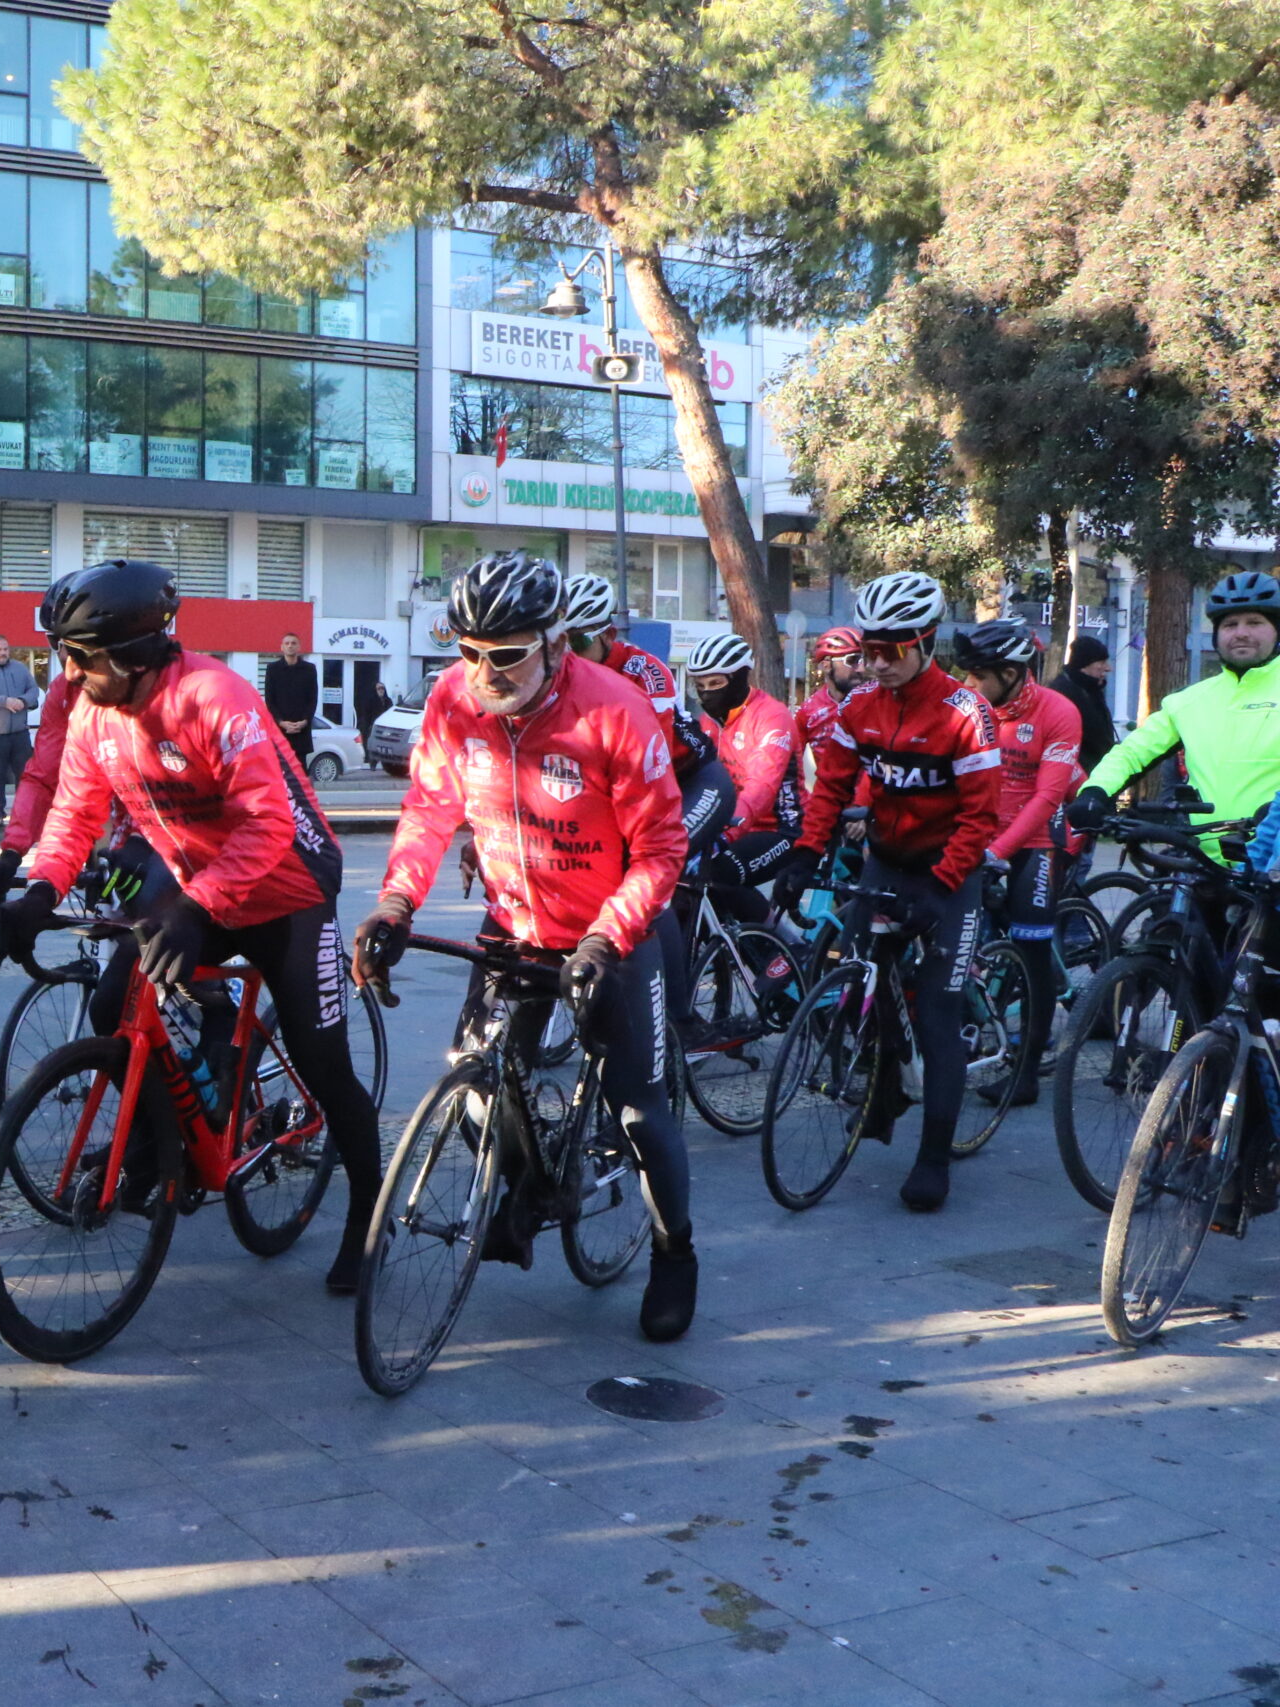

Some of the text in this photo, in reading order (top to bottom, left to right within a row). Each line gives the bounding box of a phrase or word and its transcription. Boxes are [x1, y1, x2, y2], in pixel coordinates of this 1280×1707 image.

[481, 321, 574, 351] BEREKET
[481, 345, 574, 373] SİGORTA
[503, 479, 558, 508] TARIM
[328, 625, 390, 650] AÇMAK İŞHANI
[353, 640, 365, 650] 22
[552, 838, 604, 855] ANMA
[749, 838, 791, 873] SPORTOTO
[1032, 853, 1052, 909] Divinol
[943, 908, 977, 992] İSTANBUL
[316, 917, 341, 1030] İSTANBUL
[647, 969, 665, 1085] İSTANBUL
